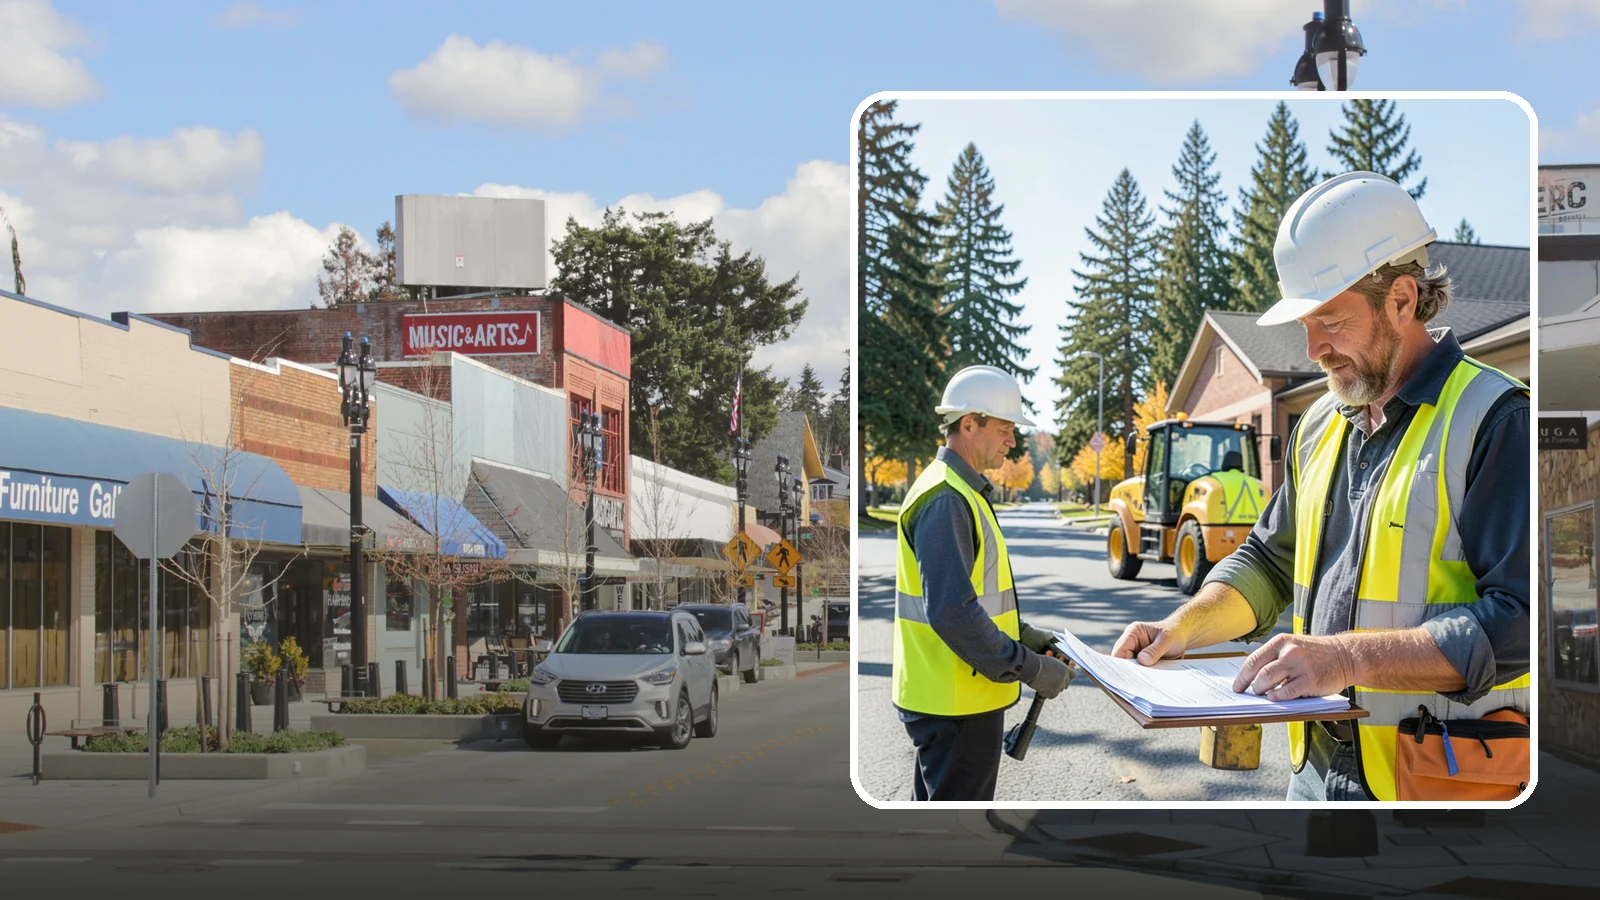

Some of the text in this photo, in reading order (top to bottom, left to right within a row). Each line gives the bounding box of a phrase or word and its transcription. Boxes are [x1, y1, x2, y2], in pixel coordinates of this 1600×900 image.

[409, 323, 519, 348] MUSIC&ARTS
[0, 471, 121, 518] Furniture Gal
